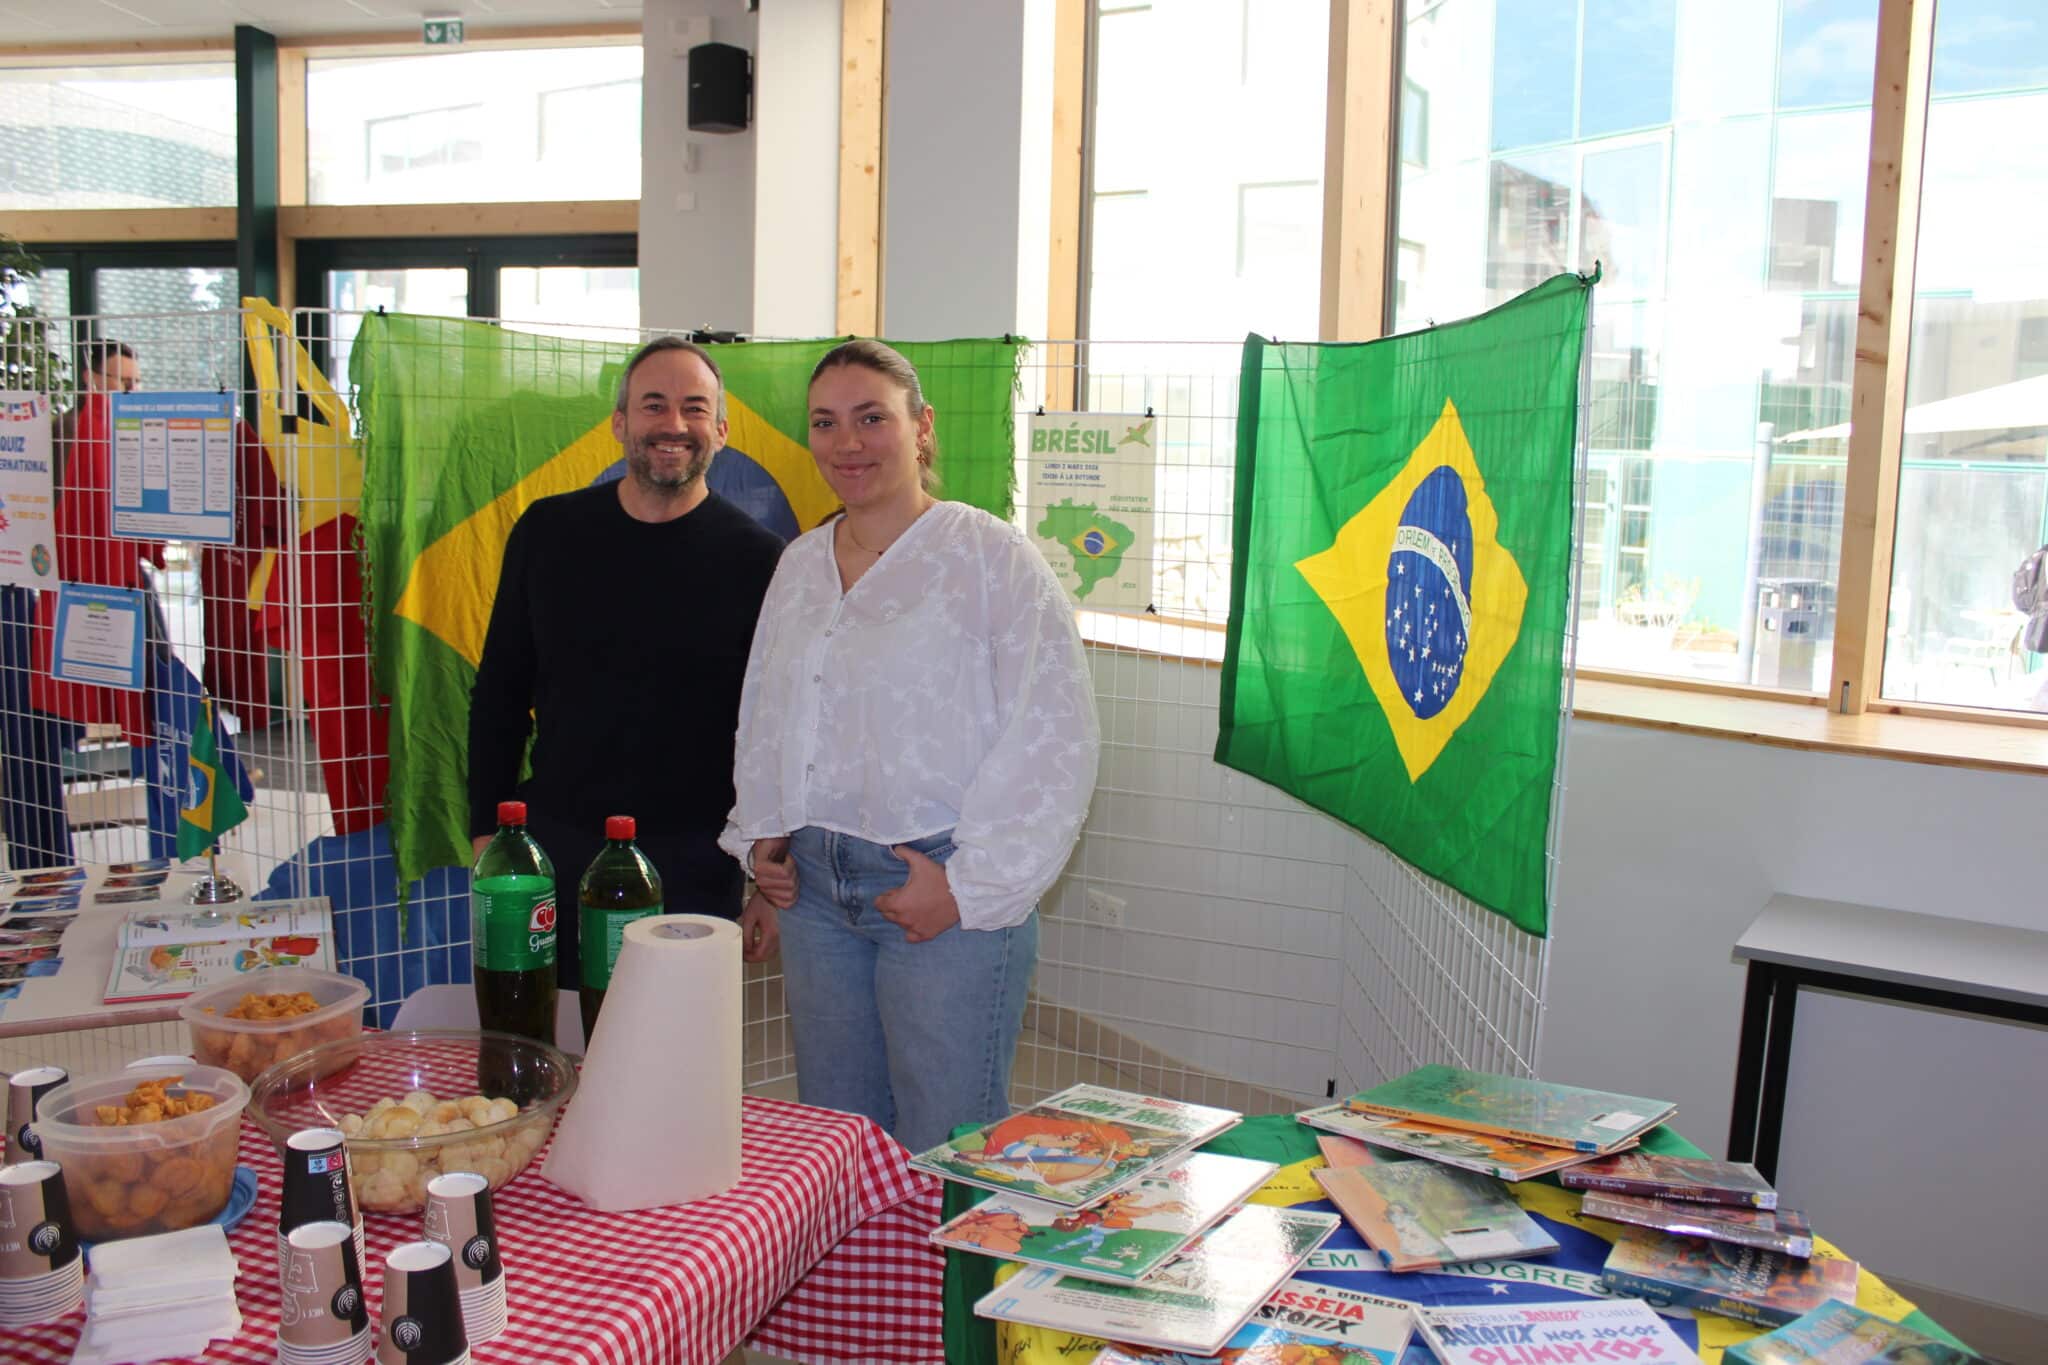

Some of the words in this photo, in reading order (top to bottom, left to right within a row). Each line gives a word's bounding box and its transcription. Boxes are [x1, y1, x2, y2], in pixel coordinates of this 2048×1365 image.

[1031, 422, 1116, 454] BRÉSIL
[1337, 1291, 1409, 1310] UDERZO
[1255, 1304, 1362, 1335] sterix
[1544, 1329, 1585, 1343] NOS
